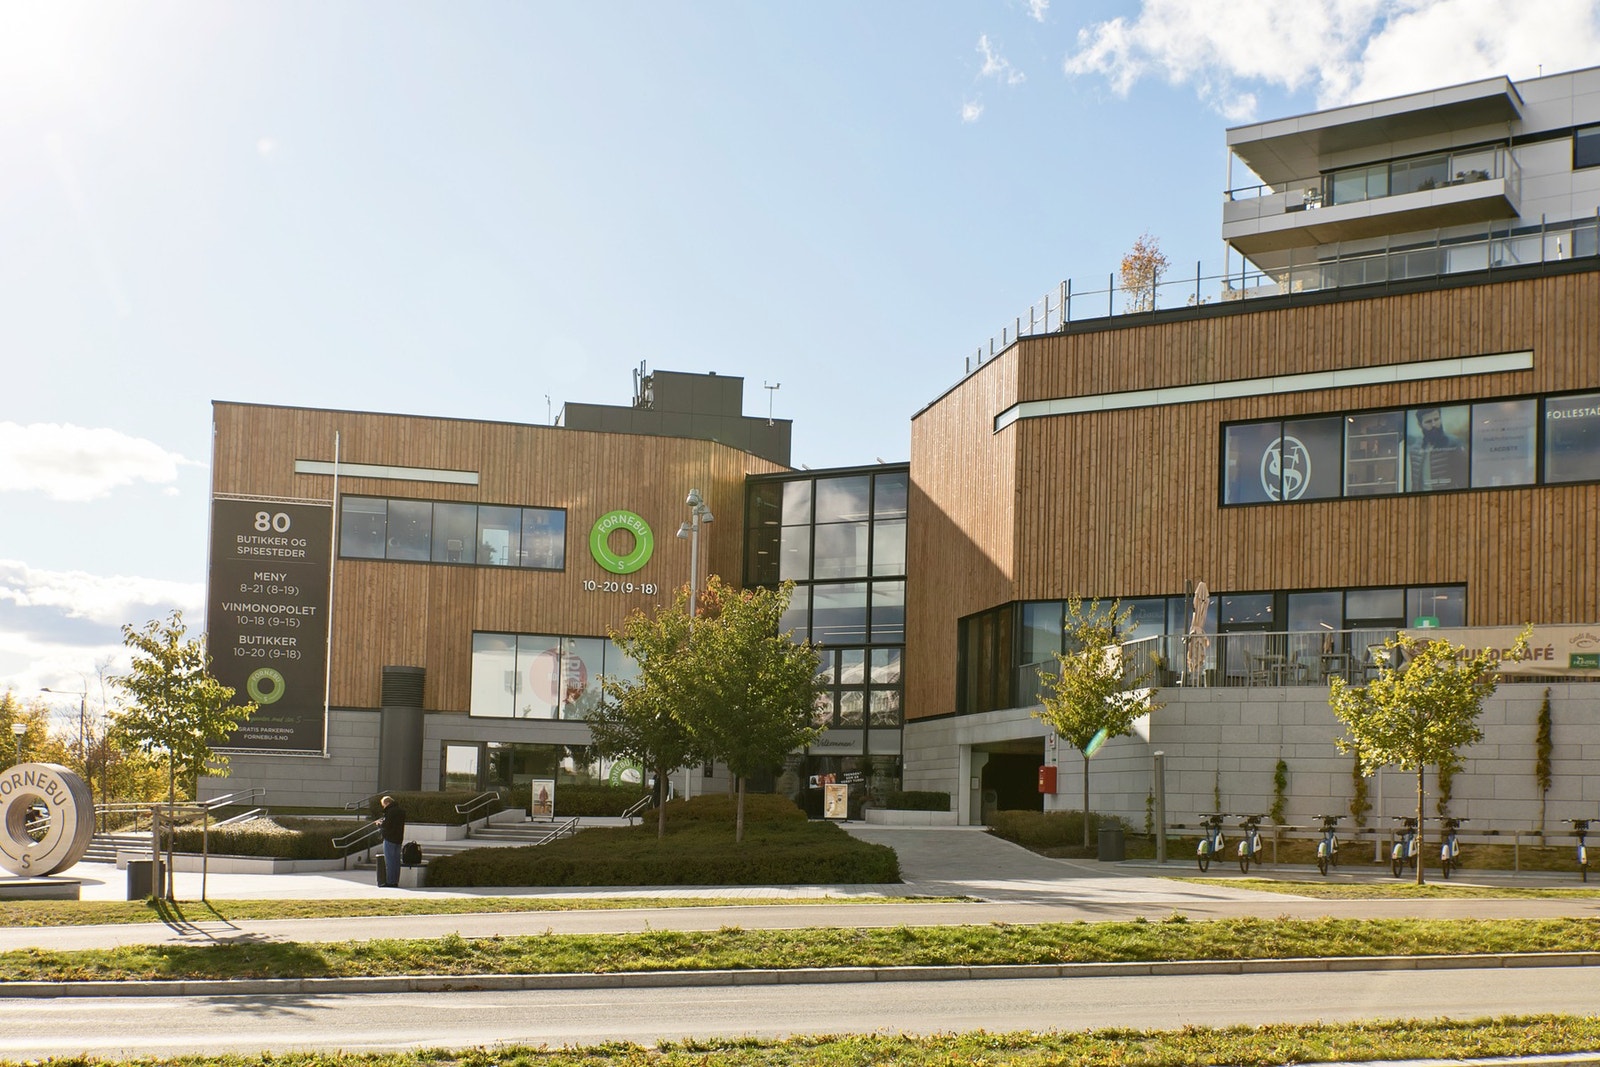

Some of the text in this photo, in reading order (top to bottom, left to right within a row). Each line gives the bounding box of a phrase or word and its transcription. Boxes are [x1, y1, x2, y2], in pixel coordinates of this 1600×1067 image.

[254, 511, 291, 533] 80
[598, 514, 647, 536] FORNEBU
[236, 534, 307, 547] BUTIKKER OG
[237, 546, 306, 558] SPISESTEDER
[618, 560, 625, 570] S
[253, 571, 287, 582] MENY
[240, 583, 300, 596] 8-21 (8-19)
[221, 602, 317, 615] VINMONOPOLET
[236, 615, 301, 628] 10-18 (9-15)
[239, 635, 297, 646] BUTIKKER
[233, 647, 302, 660] 10-20 (9-18)
[251, 670, 281, 683] FORNEBU
[0, 770, 67, 807] ORNEBU
[21, 853, 31, 870] S
